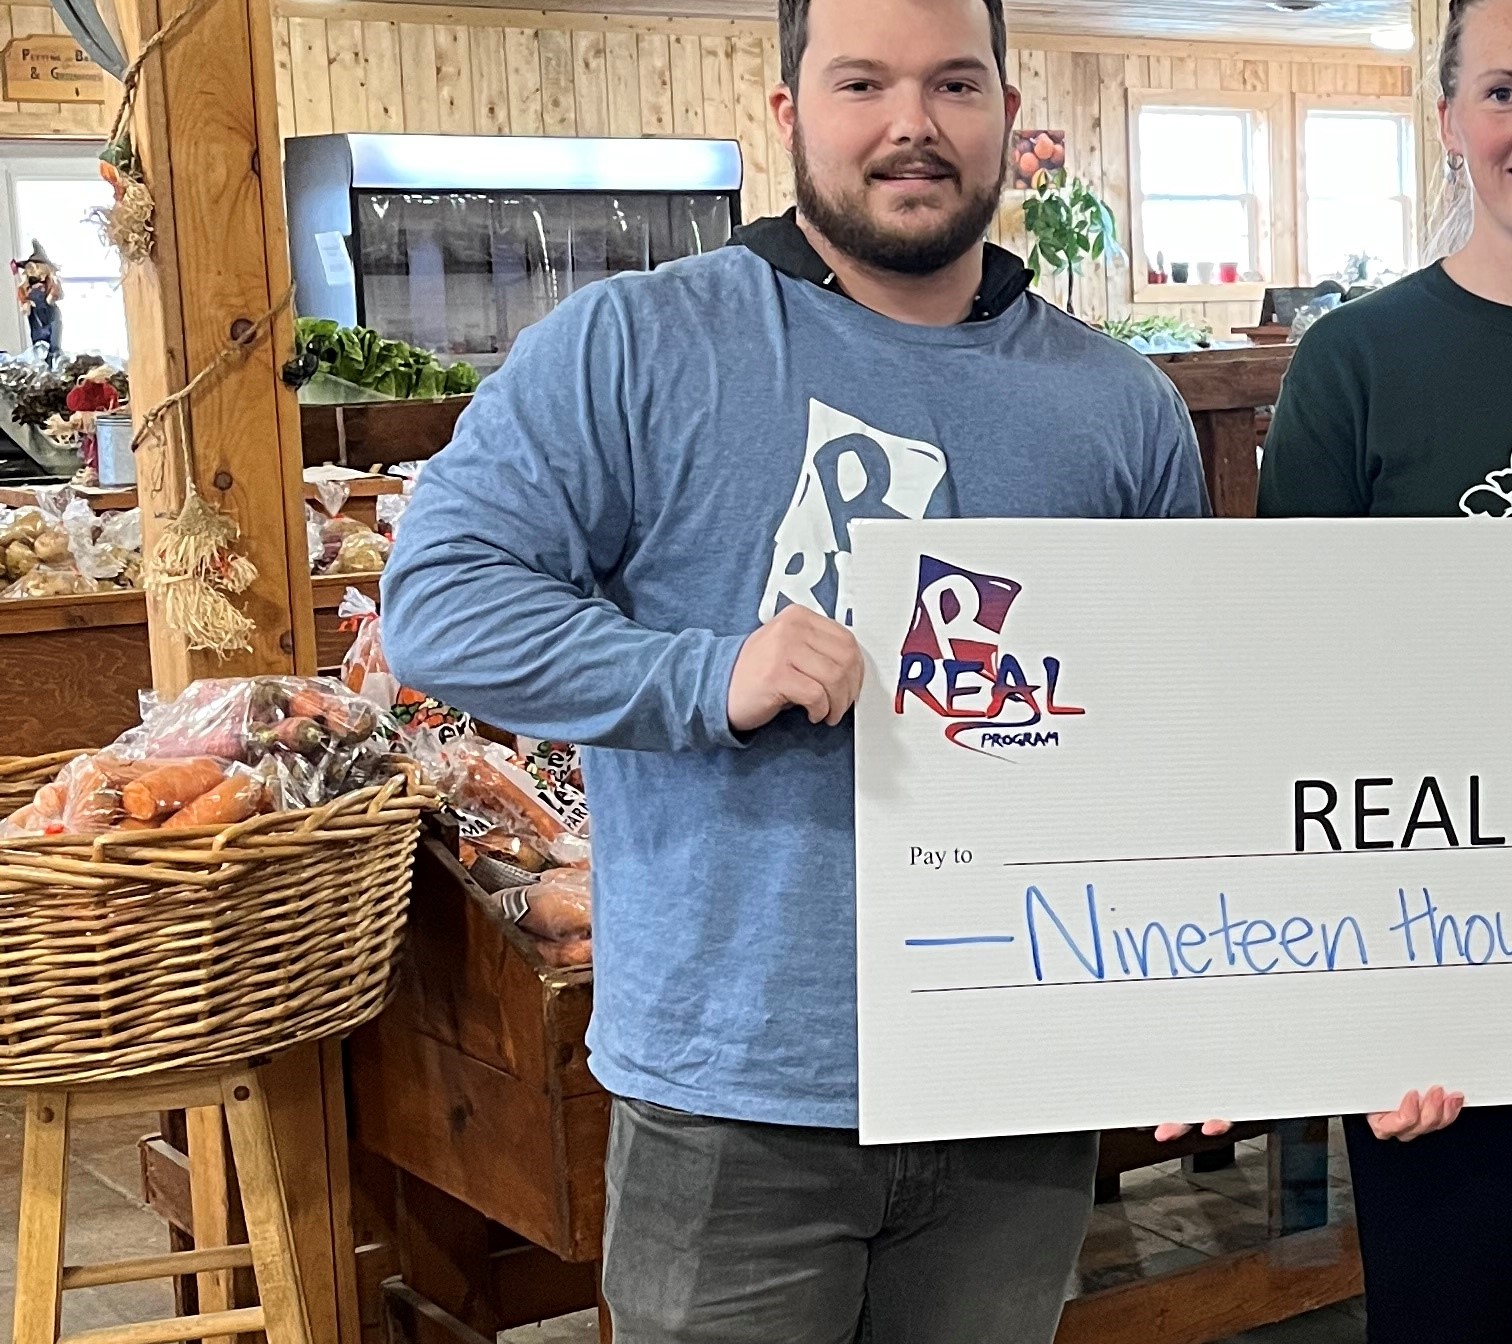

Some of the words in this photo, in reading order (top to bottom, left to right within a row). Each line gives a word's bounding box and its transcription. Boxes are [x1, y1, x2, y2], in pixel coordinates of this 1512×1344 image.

[30, 66, 40, 80] &
[894, 651, 1086, 719] REAL
[980, 731, 1060, 748] PROGRAM
[1294, 774, 1506, 852] REAL
[909, 845, 946, 869] Pay
[953, 846, 974, 867] to
[1022, 883, 1370, 982] Nineteen
